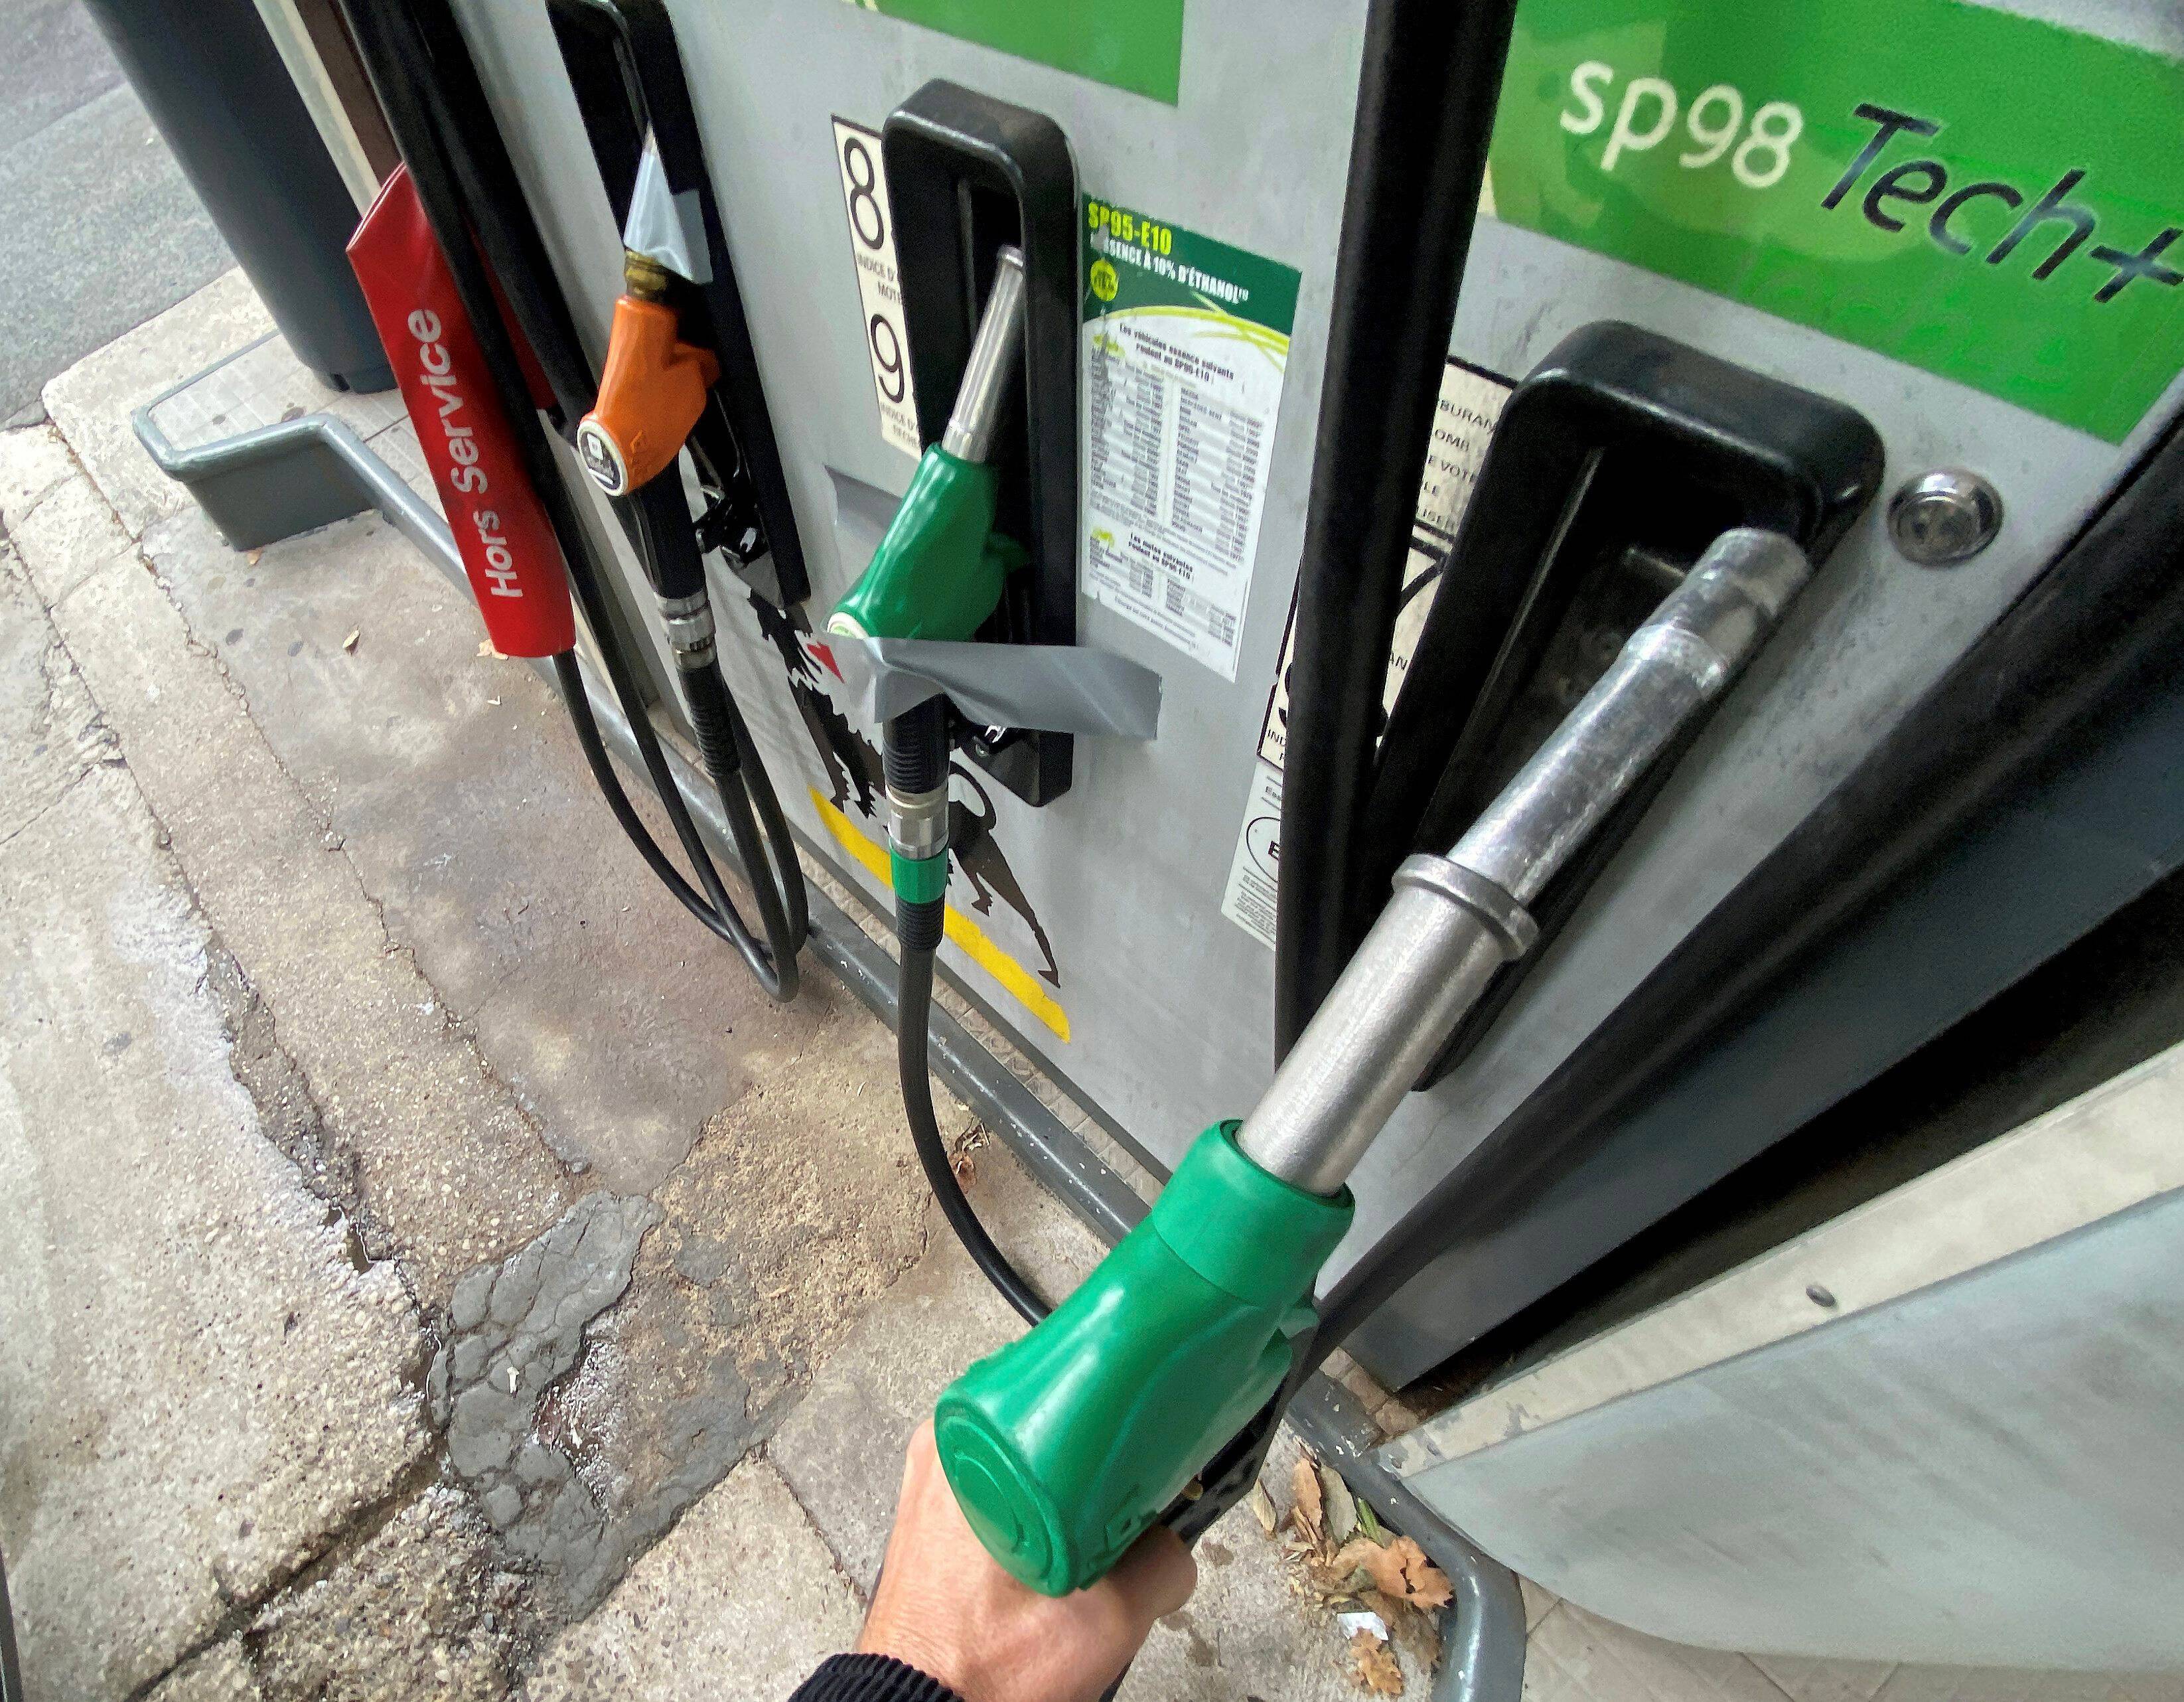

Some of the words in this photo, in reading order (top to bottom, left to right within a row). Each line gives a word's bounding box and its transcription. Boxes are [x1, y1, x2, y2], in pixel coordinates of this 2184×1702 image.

[1560, 60, 1804, 188] sp98
[1821, 103, 2184, 303] Tech+
[1088, 202, 1173, 256] SP95-E10
[1153, 256, 1176, 280] 10%
[408, 309, 488, 494] Service
[473, 509, 523, 598] Hors
